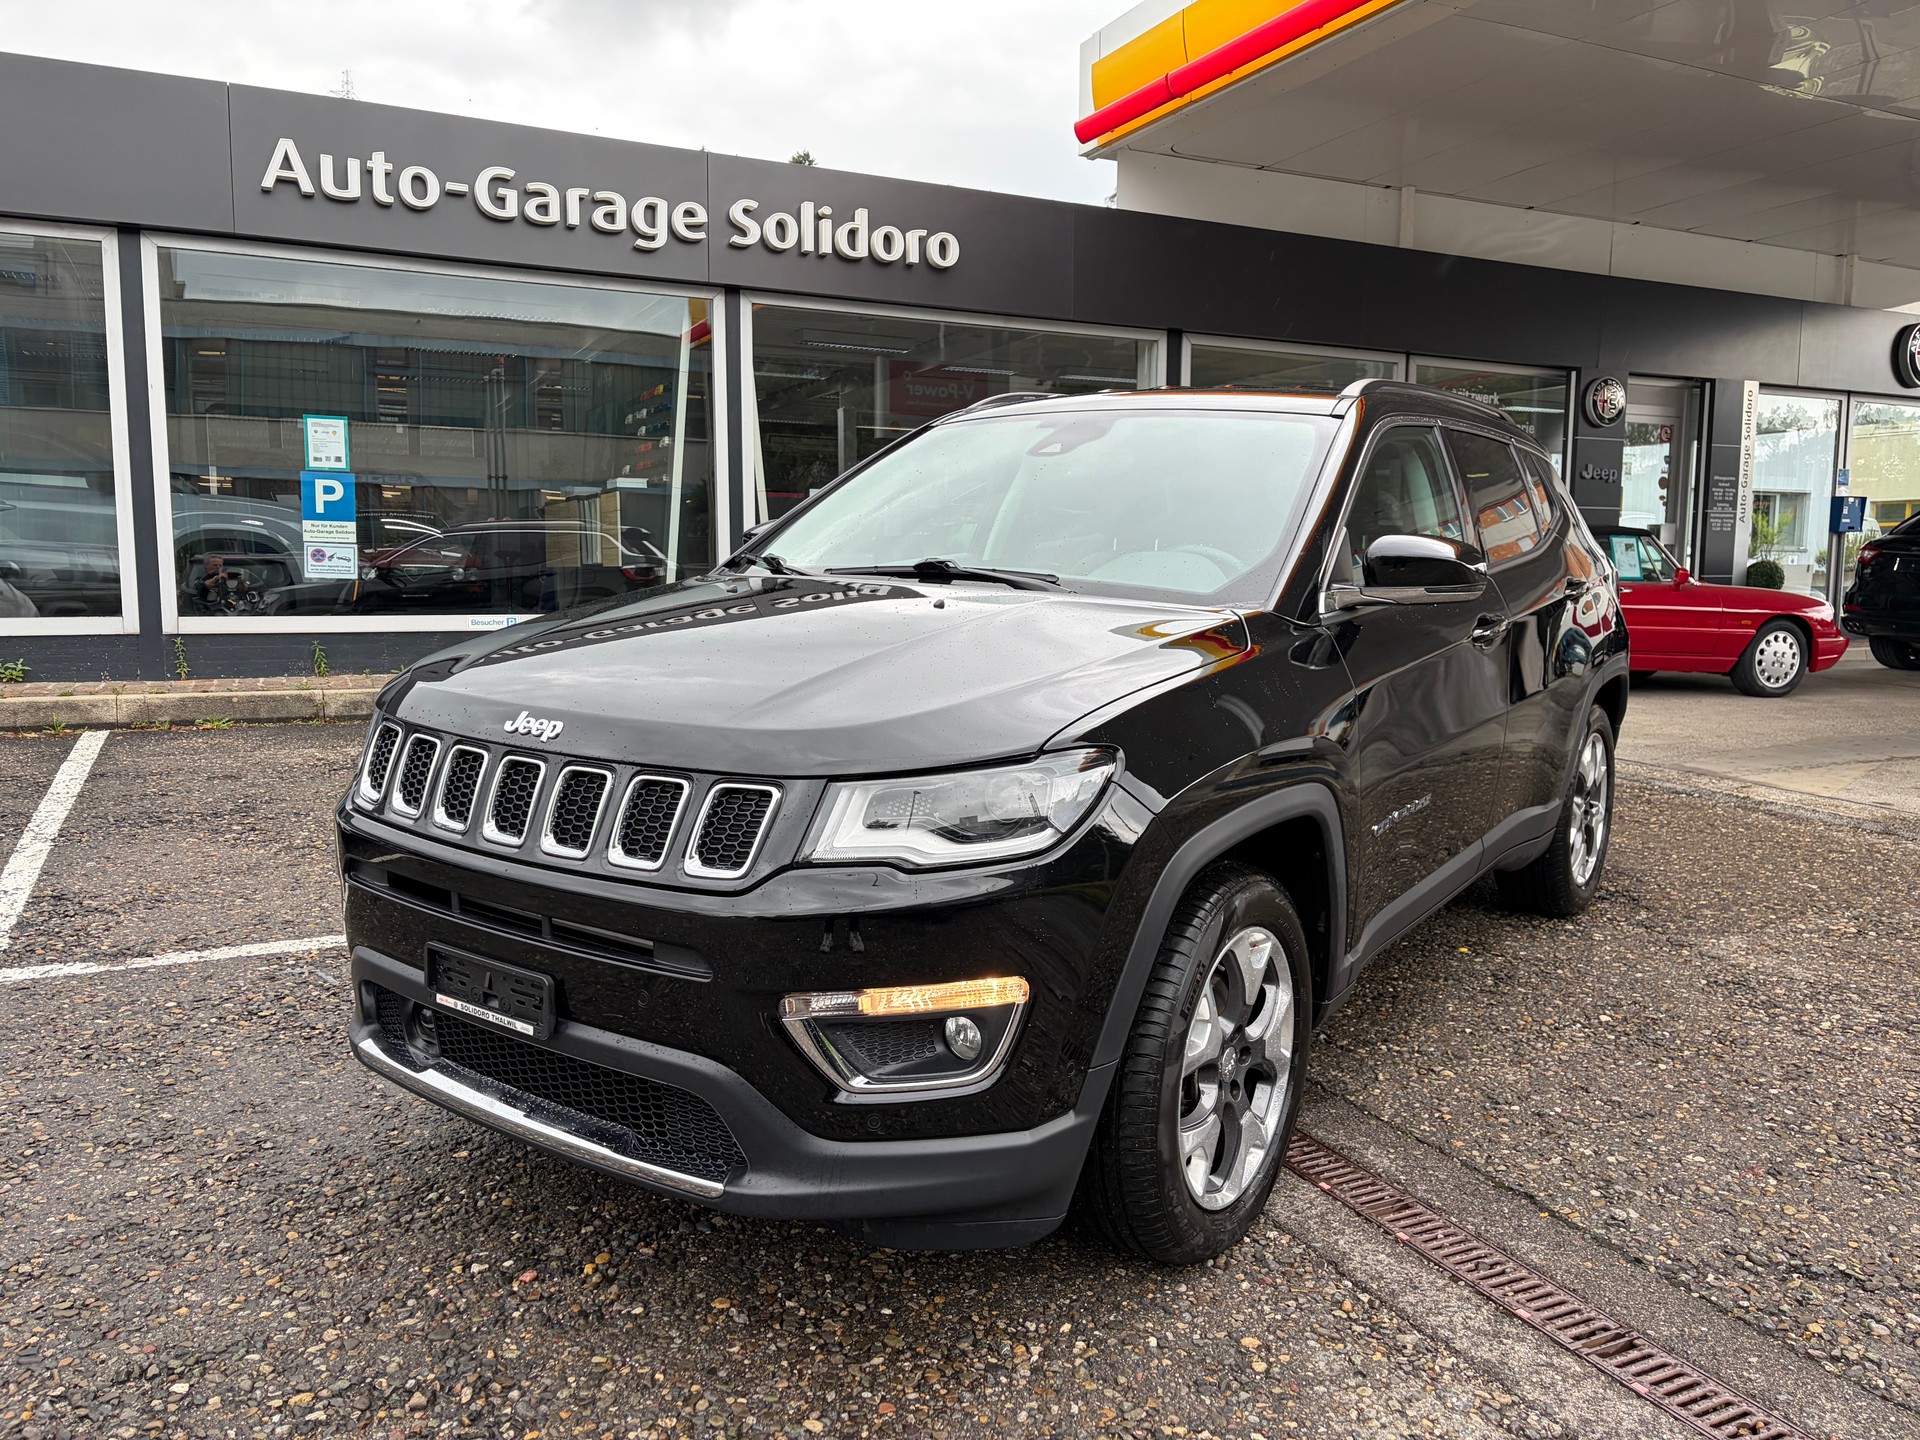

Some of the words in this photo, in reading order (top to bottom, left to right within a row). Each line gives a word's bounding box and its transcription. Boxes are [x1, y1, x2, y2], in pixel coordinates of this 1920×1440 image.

[261, 137, 707, 251] Auto-Garage
[728, 198, 960, 269] Solidoro
[1744, 389, 1753, 440] Solidoro
[1581, 463, 1618, 483] Jeep
[1739, 445, 1751, 523] Auto-Garage
[315, 478, 344, 514] P
[471, 618, 504, 626] Besucher
[503, 710, 564, 743] Jeep
[460, 1003, 490, 1019] SOLIDORO
[491, 1014, 518, 1030] THALWIL
